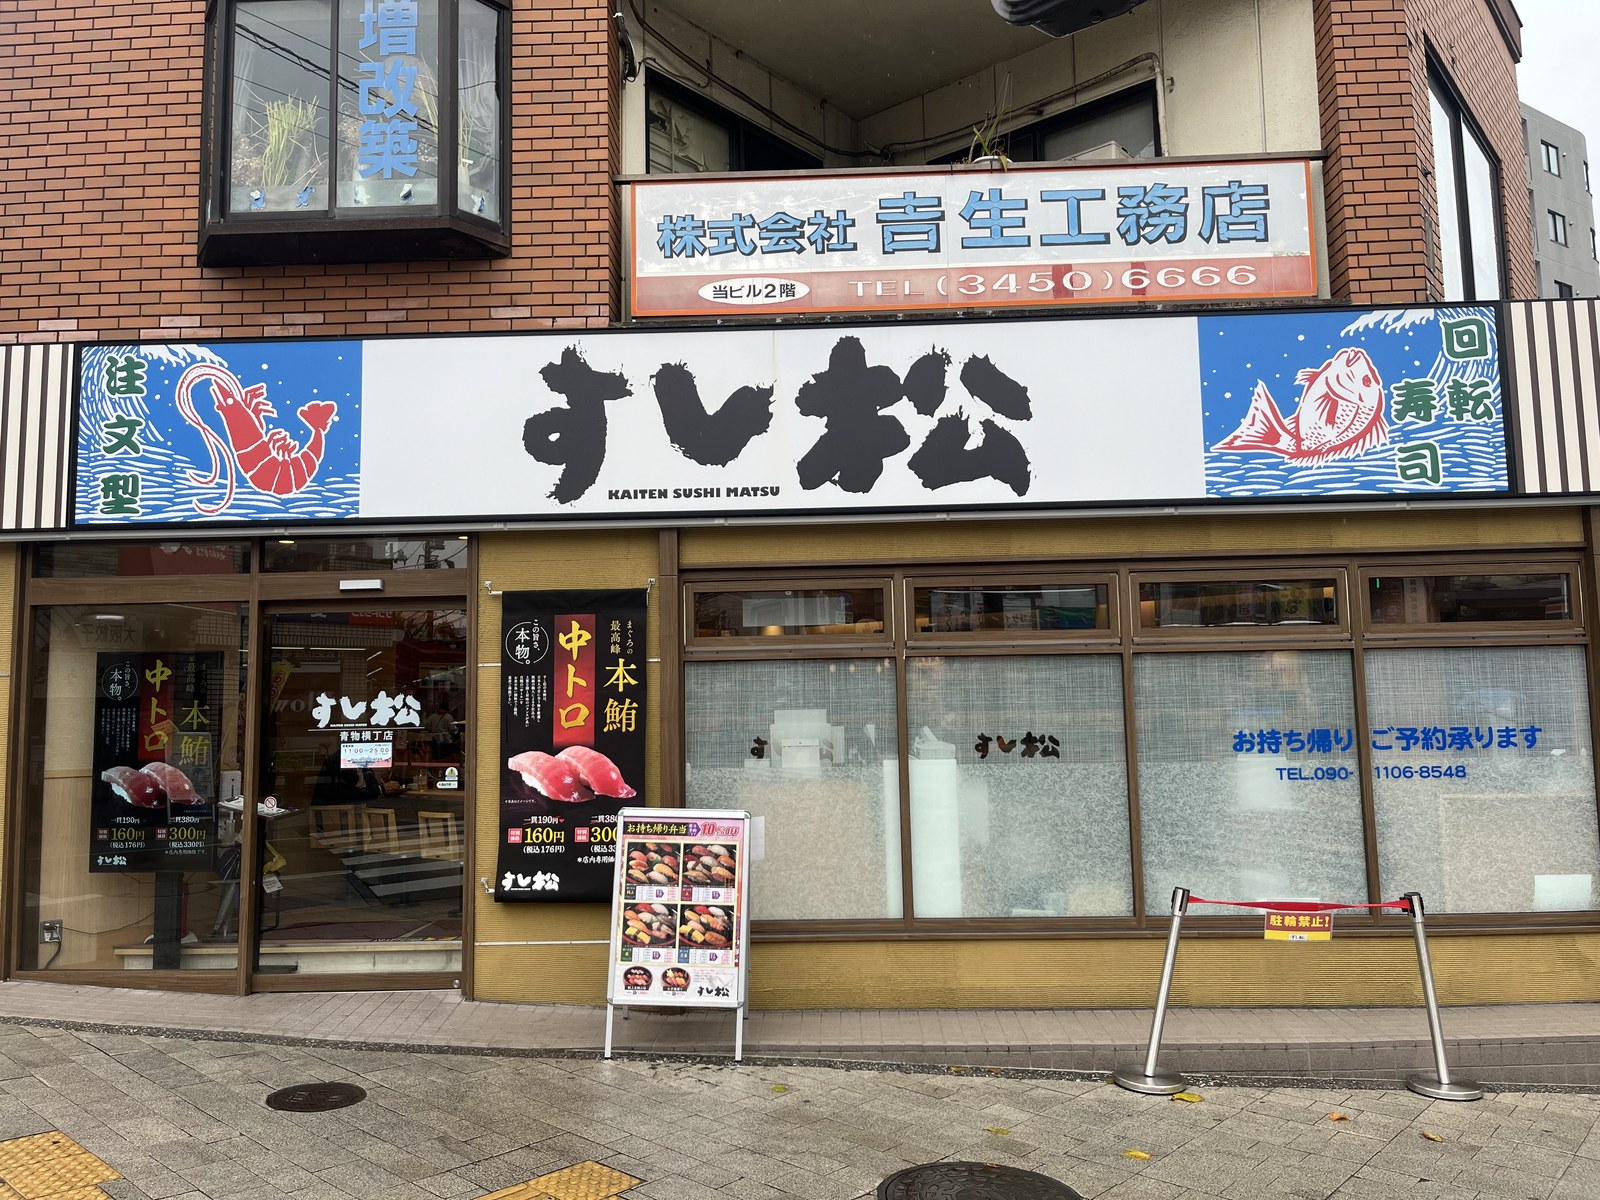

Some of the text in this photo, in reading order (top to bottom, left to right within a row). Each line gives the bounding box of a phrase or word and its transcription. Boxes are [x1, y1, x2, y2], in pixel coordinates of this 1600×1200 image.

[358, 0, 418, 179] 増改築
[656, 209, 857, 259] 株式会社
[712, 283, 796, 299] 当ビル2階
[849, 280, 924, 297] TEL
[1442, 318, 1495, 421] 回転
[101, 355, 147, 515] 注文型
[523, 336, 1033, 505] すし松
[1391, 379, 1441, 485] 寿司
[608, 486, 780, 500] KAITEN SUSHI MATSU
[514, 627, 531, 665] 本物。
[610, 620, 621, 655] 最高峰
[626, 620, 634, 655] まぐろの
[558, 620, 592, 729] 中トロ
[144, 659, 172, 752] 中トロ
[312, 690, 421, 729] すし松
[603, 657, 639, 733] 本鮪
[179, 700, 211, 766] 本鮪
[340, 730, 394, 742] 青物横丁店
[975, 731, 1061, 760] すし松
[1233, 725, 1543, 754] お持ち帰り ご予約承ります
[1375, 765, 1467, 780] 1106-8548
[111, 827, 145, 841] 160円
[169, 826, 206, 841] 300円
[524, 827, 565, 843] 160円
[627, 823, 687, 834] お持ち帰り弁当
[97, 855, 127, 866] すし松
[523, 845, 565, 854] (税込176円)
[501, 871, 560, 892] すし松
[1269, 914, 1330, 928] 駐輪禁止!
[697, 986, 730, 997] すし松
